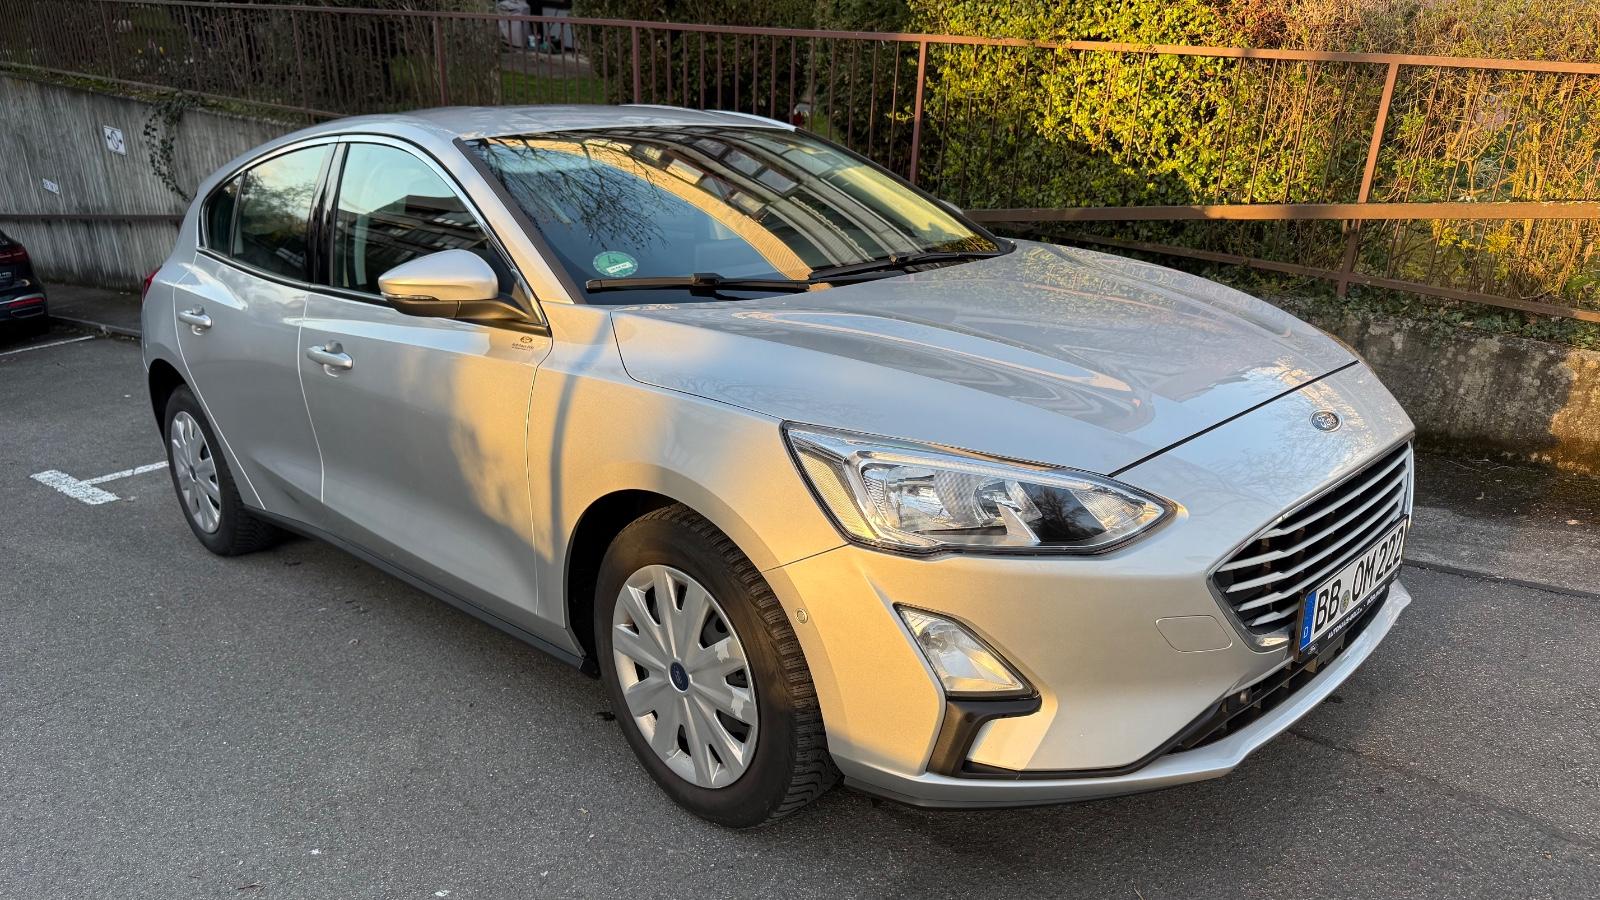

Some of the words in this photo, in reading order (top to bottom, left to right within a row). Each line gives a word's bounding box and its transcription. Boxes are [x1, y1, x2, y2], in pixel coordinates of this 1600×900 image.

[1314, 578, 1342, 634] BB
[1351, 549, 1378, 602] OM
[1375, 526, 1404, 583] 222
